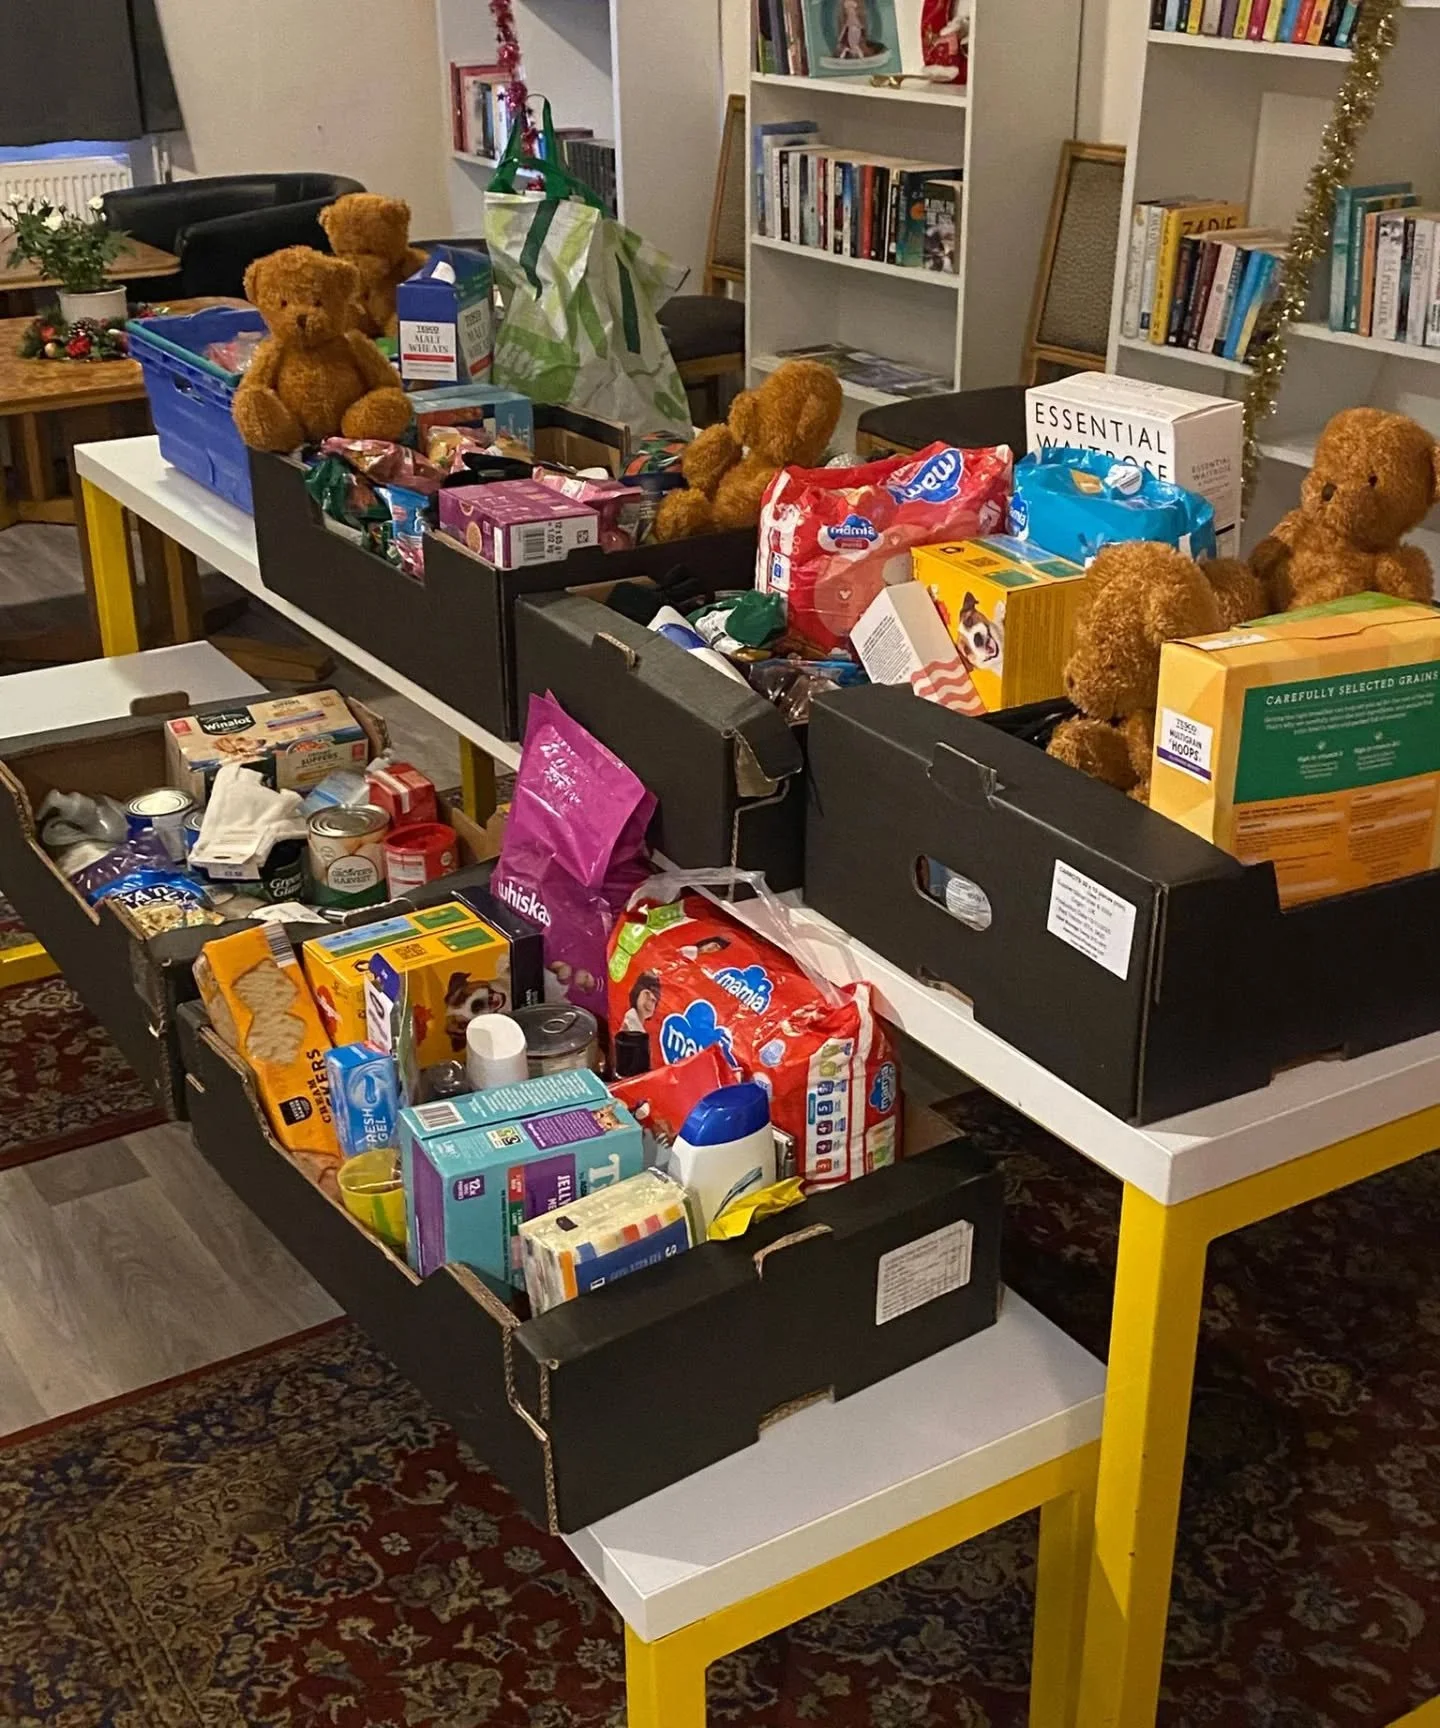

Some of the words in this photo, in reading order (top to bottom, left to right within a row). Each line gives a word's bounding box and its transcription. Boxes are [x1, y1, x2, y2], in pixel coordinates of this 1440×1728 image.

[408, 343, 449, 353] WHEATS
[415, 334, 440, 344] MALT
[1035, 402, 1167, 454] ESSENTIAL
[830, 524, 876, 536] mamia
[1265, 687, 1335, 706] CAREFULLY
[1338, 677, 1395, 695] SELECTED
[1398, 670, 1439, 686] GRAINS
[203, 716, 252, 732] Winalot
[1176, 718, 1197, 734] TESCO
[1169, 728, 1202, 749] MULTIGRAIN
[1171, 740, 1200, 761] HOOPS
[331, 867, 373, 877] GROWERS
[332, 875, 372, 884] HARVEST
[498, 880, 551, 928] whiskas
[717, 972, 765, 1012] mamia
[880, 1064, 893, 1110] mamia
[376, 1115, 389, 1141] GEL
[556, 1174, 571, 1207] JELLY
